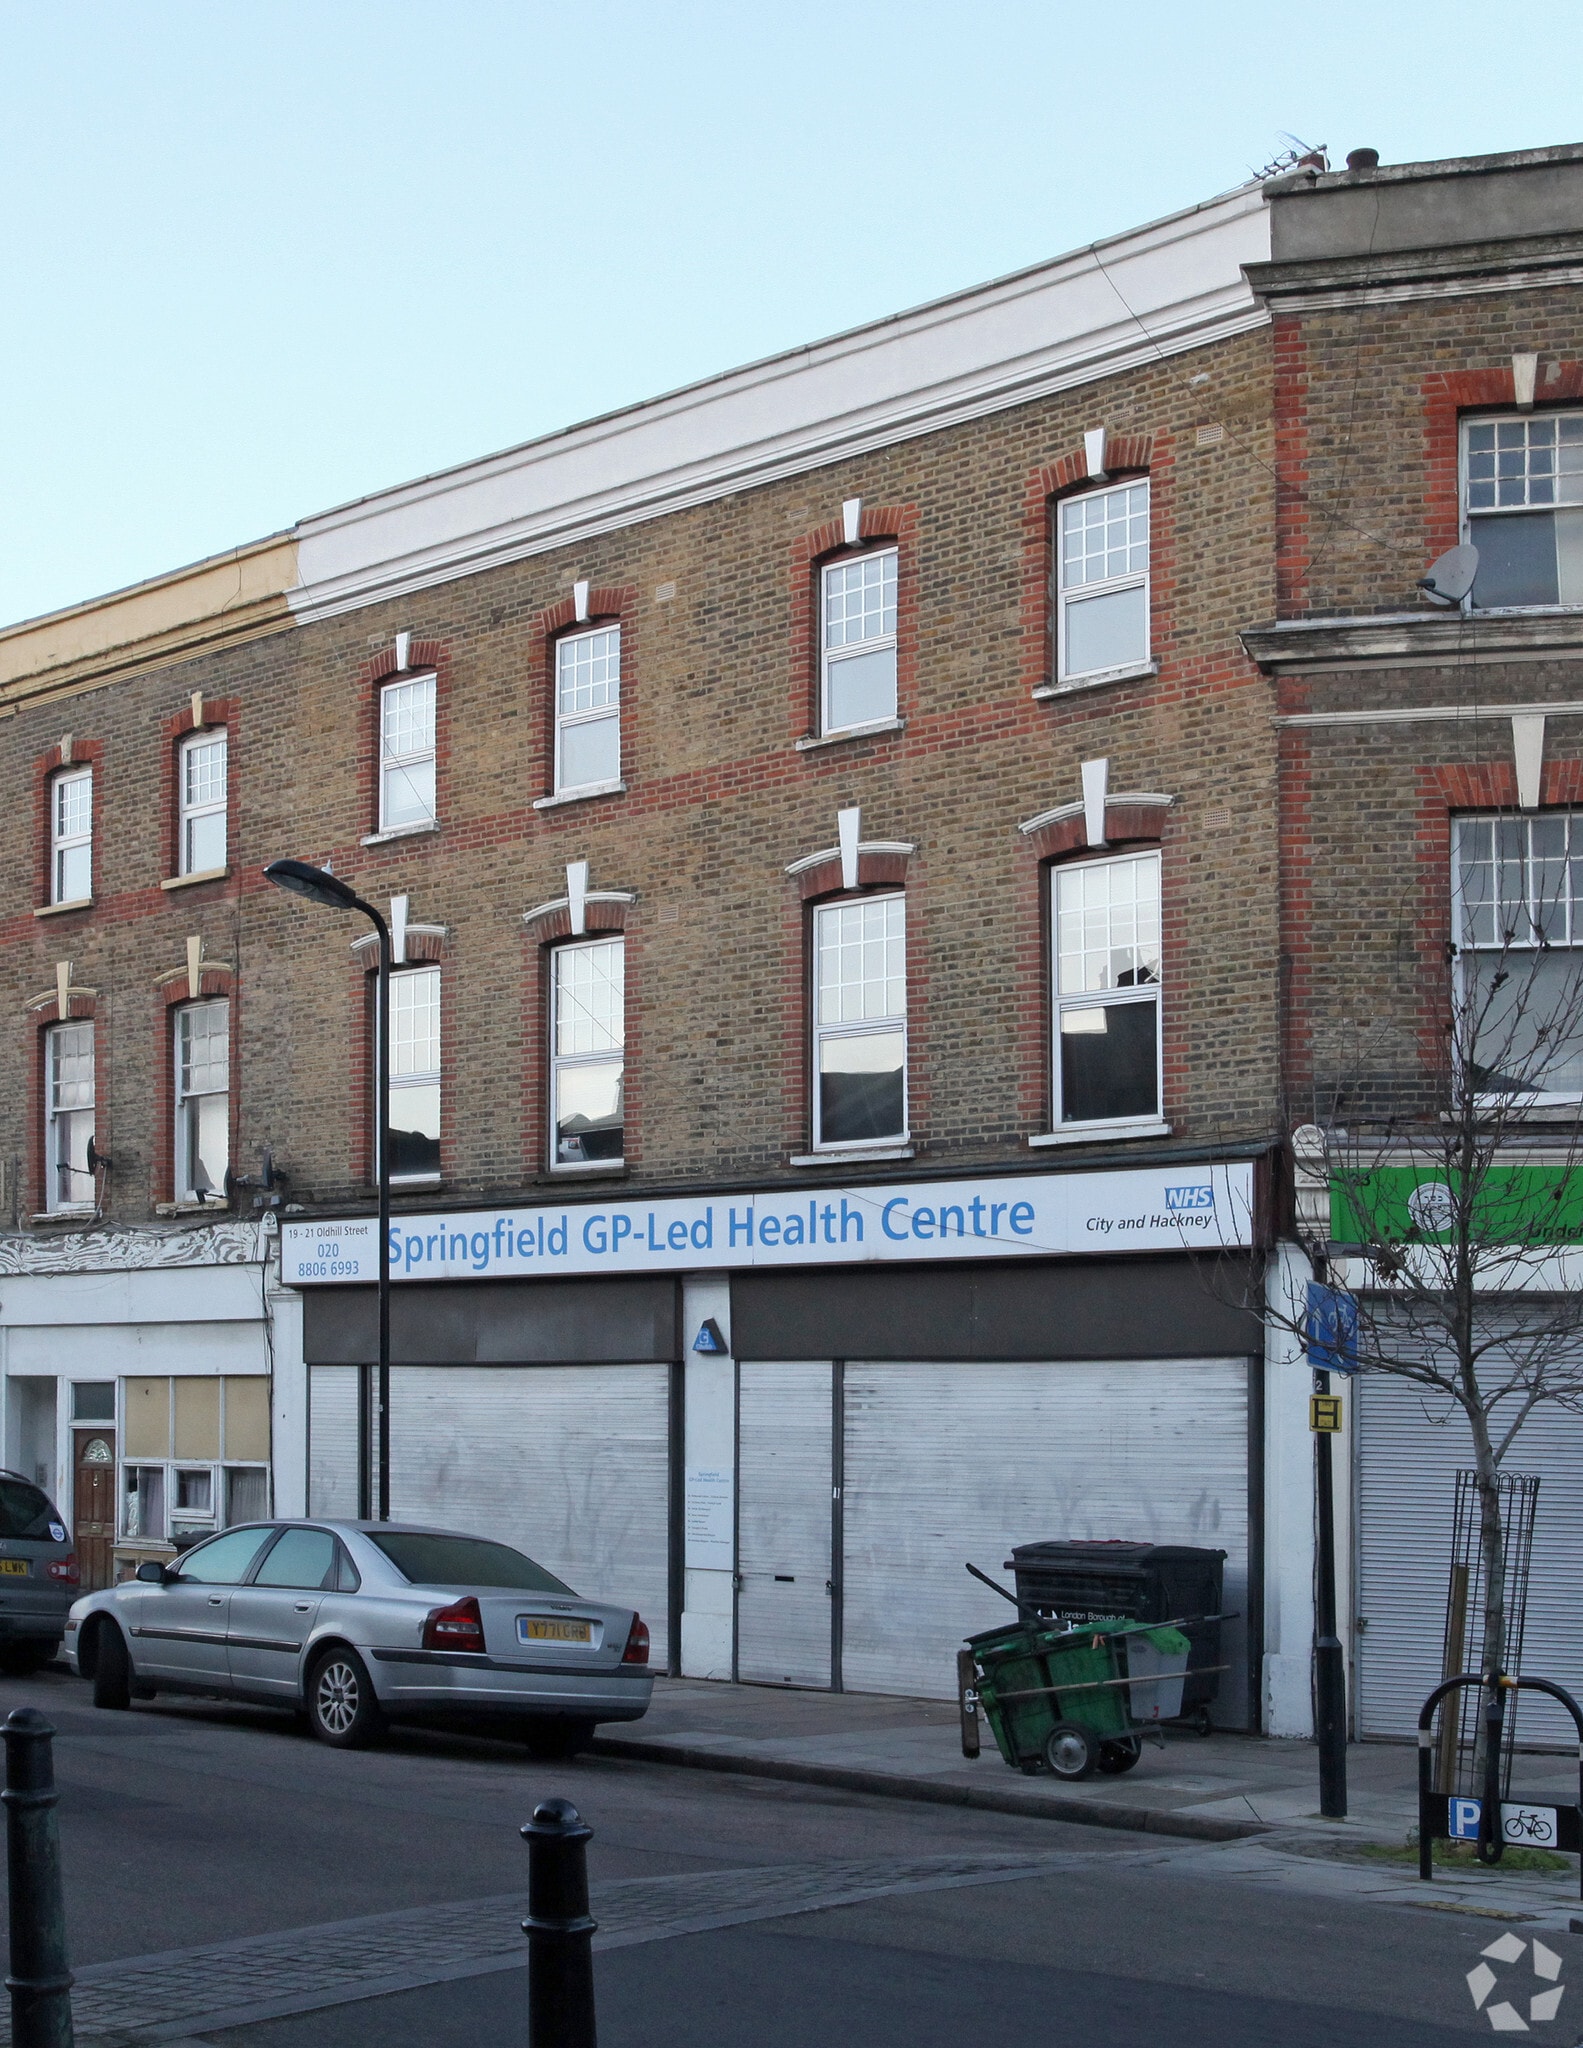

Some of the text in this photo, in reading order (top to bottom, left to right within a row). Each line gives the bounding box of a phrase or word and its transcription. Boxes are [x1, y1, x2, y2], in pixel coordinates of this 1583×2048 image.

[1166, 1187, 1212, 1208] NHS
[1086, 1213, 1213, 1234] City and Hackney
[289, 1229, 298, 1239] 19
[305, 1228, 314, 1238] 21
[317, 1225, 342, 1238] Oldhill
[344, 1225, 369, 1236] Street
[388, 1195, 1035, 1272] Springfield GP-Led Health Centre
[317, 1243, 339, 1258] 020
[298, 1260, 359, 1276] 8806 6993
[1315, 1380, 1323, 1391] 2
[1061, 1610, 1086, 1620] London
[1087, 1612, 1116, 1622] Borough
[1456, 1801, 1481, 1835] P
